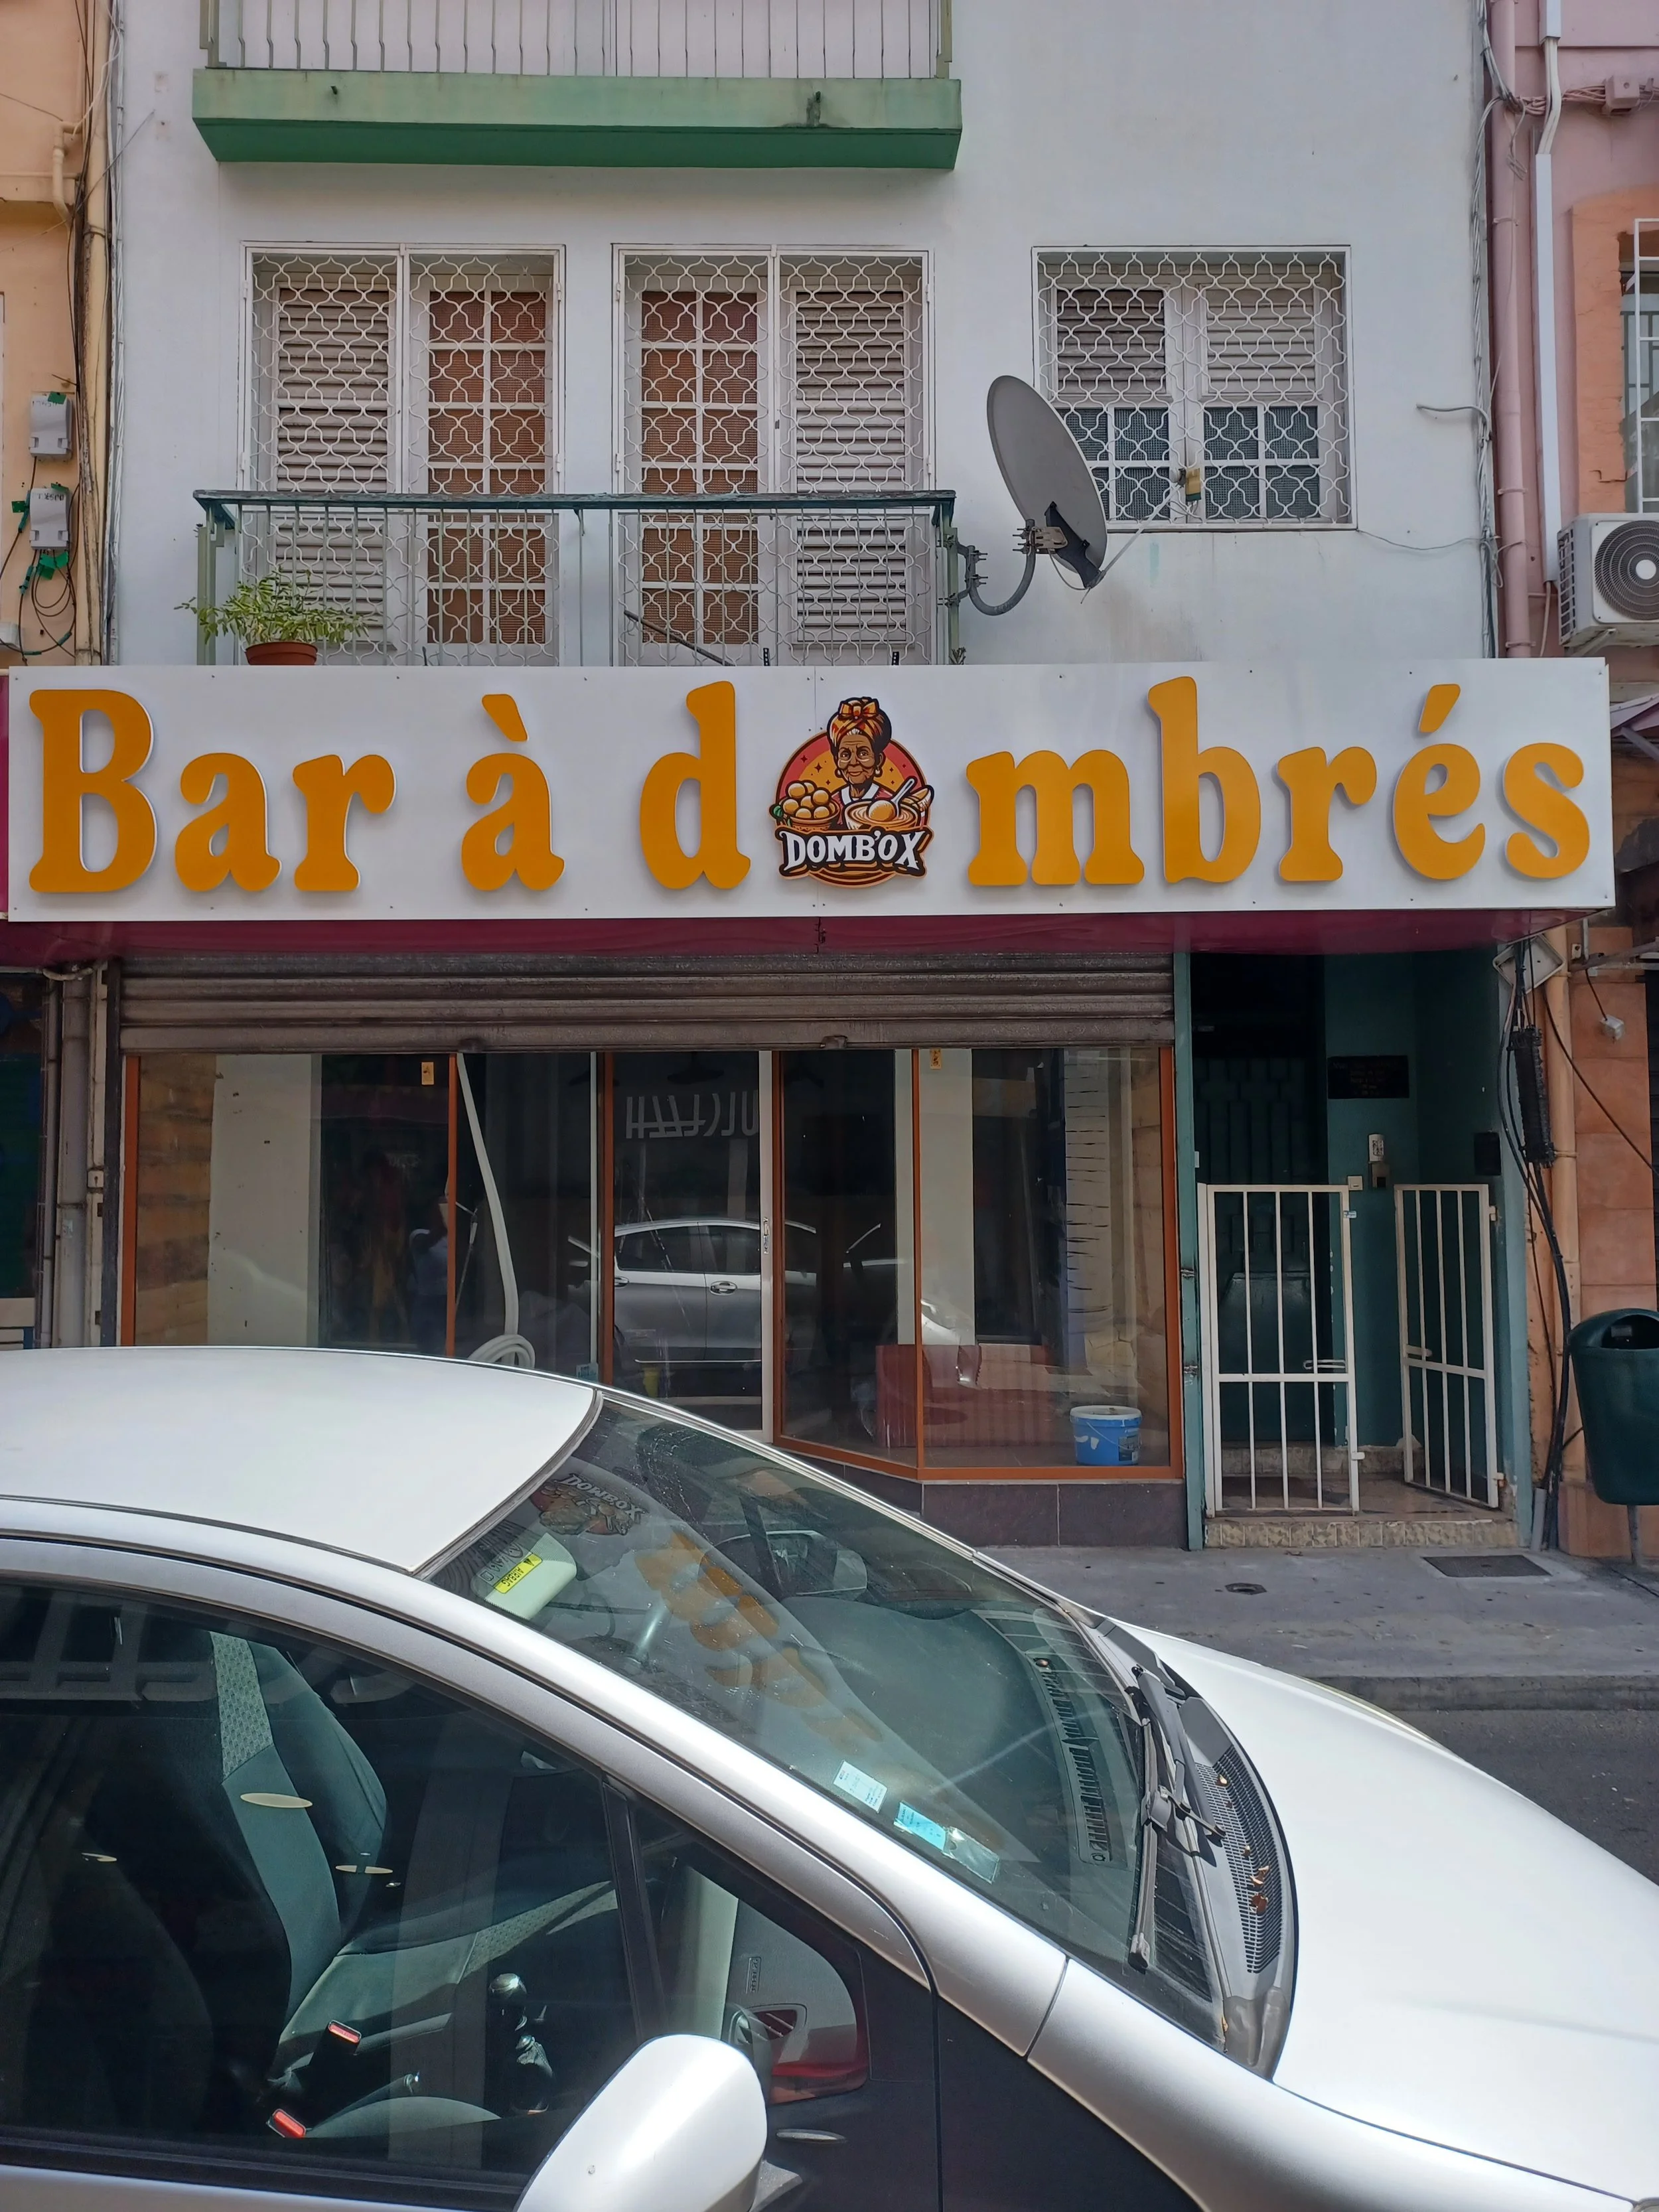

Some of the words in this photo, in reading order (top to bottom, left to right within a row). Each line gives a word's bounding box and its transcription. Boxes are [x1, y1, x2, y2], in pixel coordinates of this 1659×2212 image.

[29, 689, 396, 893] Bar
[461, 694, 565, 891] à
[779, 830, 926, 871] DOMB'OX
[501, 1566, 524, 1587] AIRBAG
